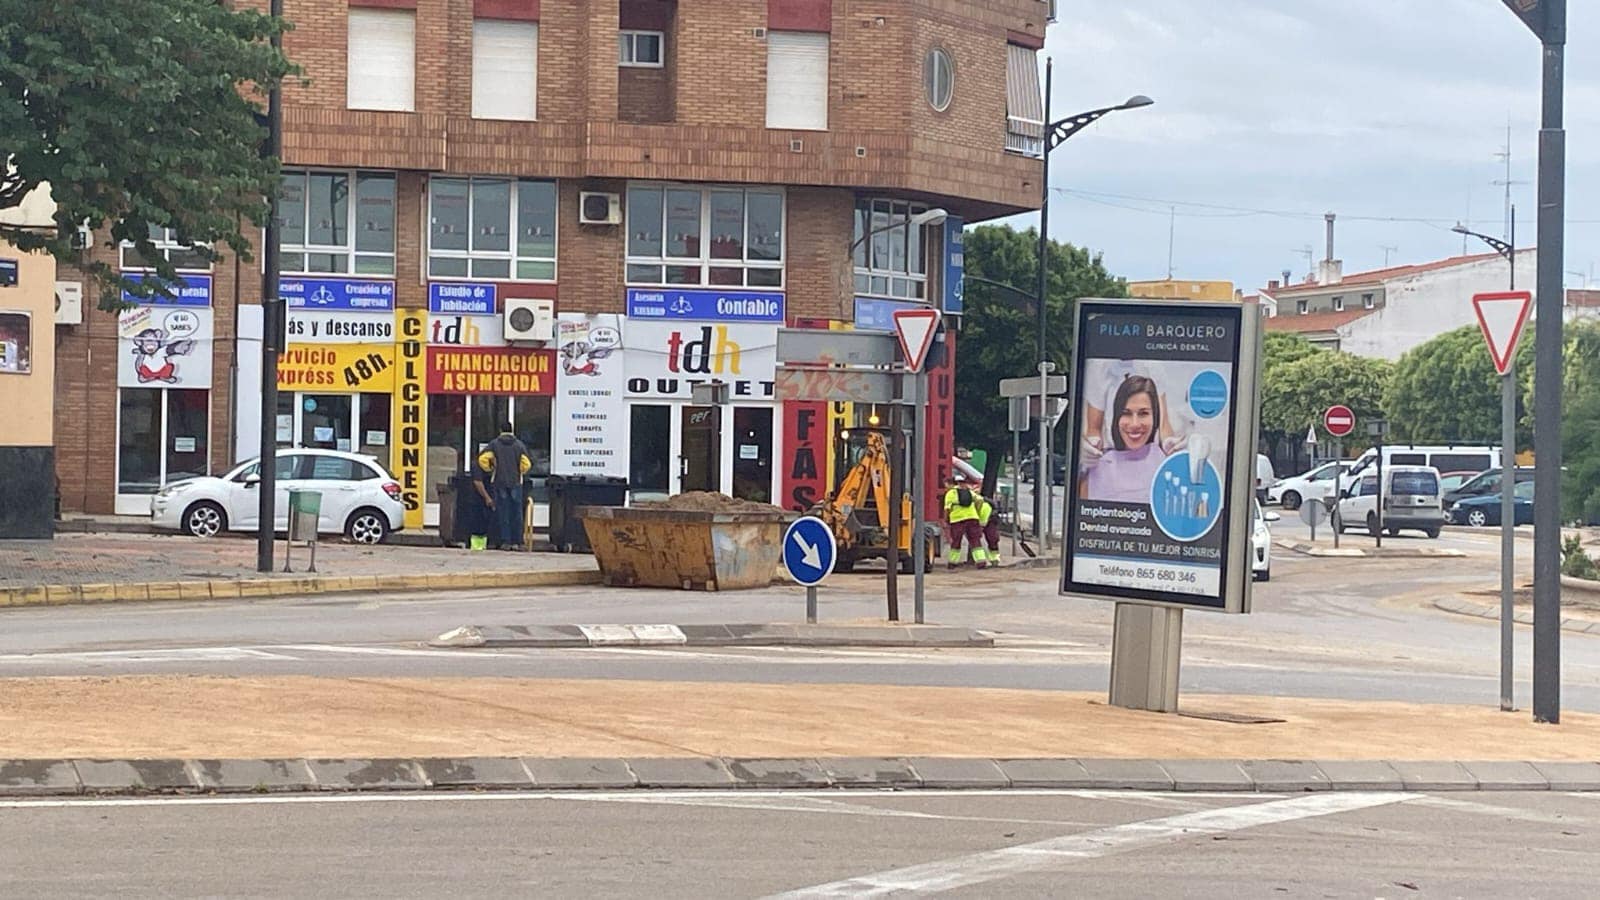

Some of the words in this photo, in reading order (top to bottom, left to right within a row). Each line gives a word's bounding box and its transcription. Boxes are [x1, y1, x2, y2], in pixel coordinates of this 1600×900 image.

[345, 283, 380, 295] Creación
[381, 284, 392, 295] de
[439, 286, 472, 298] Estudio
[473, 286, 486, 298] de
[350, 297, 388, 307] empresas
[440, 299, 487, 312] Jubilación
[717, 297, 778, 316] Contable
[289, 317, 304, 334] ás
[311, 320, 319, 337] y
[326, 319, 392, 337] descanso
[432, 316, 480, 345] tdh
[1099, 323, 1141, 337] PILAR
[1146, 325, 1226, 339] BARQUERO
[668, 324, 741, 374] tdh
[1180, 343, 1210, 352] DENTAL
[277, 348, 337, 366] ervicio
[436, 353, 549, 373] FINANCIACIÓN
[277, 367, 335, 384] xpréss
[344, 353, 393, 386] 48h.
[480, 374, 540, 392] MEDIDA
[628, 378, 775, 396] OUTET
[402, 317, 421, 511] COLCHONES
[792, 409, 817, 511] FÁS
[1080, 521, 1108, 533] Dental
[1109, 525, 1152, 536] avanzada
[1079, 538, 1121, 551] DISFRUTA
[1123, 541, 1135, 552] DE
[1137, 542, 1149, 553] TU
[1152, 543, 1181, 556] MEJOR
[1183, 546, 1221, 559] SONRISA
[1099, 564, 1134, 578] Teléfono
[1136, 567, 1155, 580] 865
[1157, 569, 1176, 581] 680
[1178, 571, 1197, 583] 346
